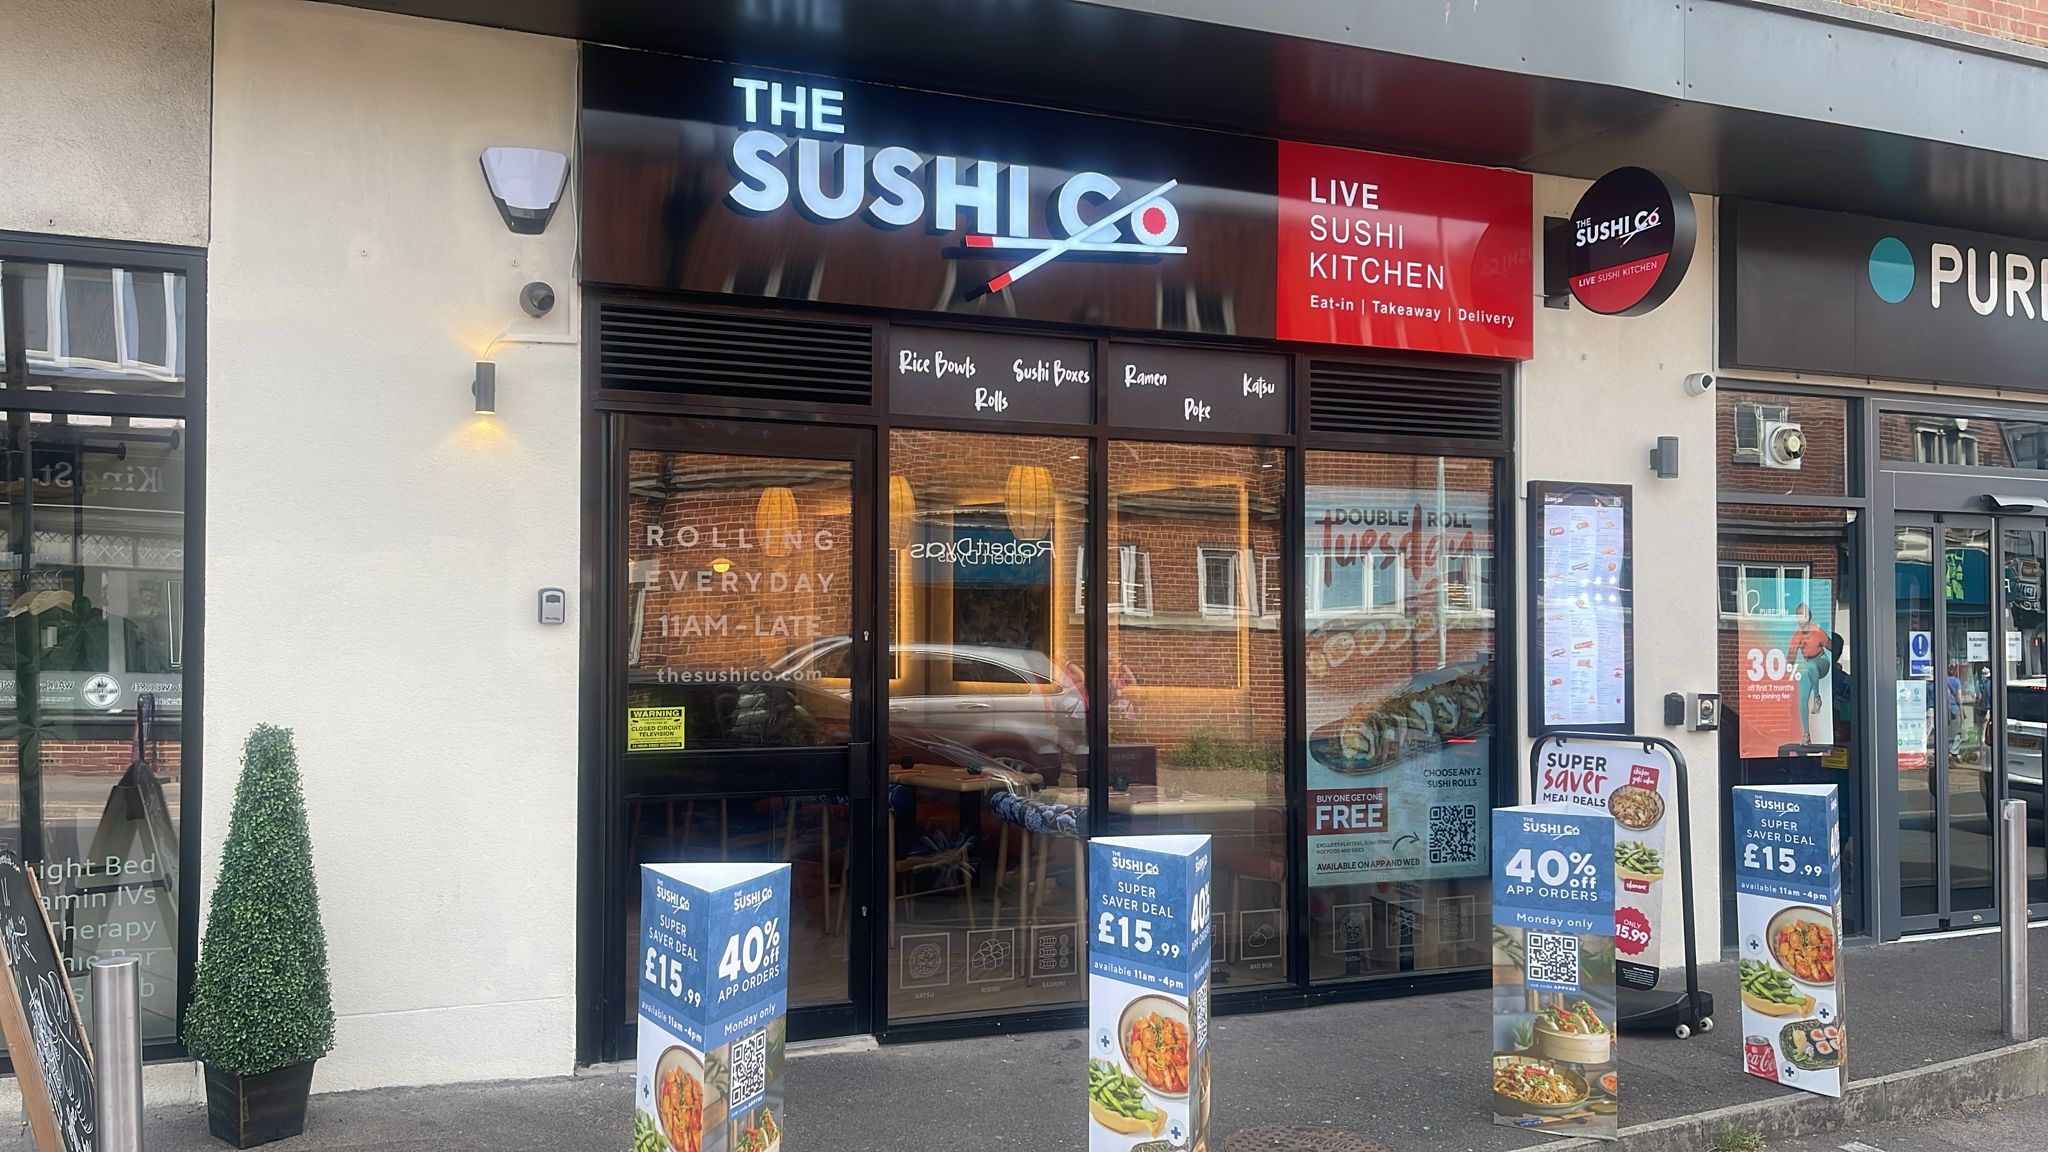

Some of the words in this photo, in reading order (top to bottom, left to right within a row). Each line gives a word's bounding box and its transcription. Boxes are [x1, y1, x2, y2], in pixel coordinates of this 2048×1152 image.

[733, 77, 845, 134] THE
[729, 130, 1029, 238] SUSHI
[1310, 177, 1379, 210] LIVE
[1310, 214, 1403, 250] SUSHI
[1576, 217, 1591, 229] THE
[1576, 215, 1630, 247] SUSHI
[1310, 252, 1444, 290] KITCHEN
[1578, 276, 1596, 287] LIVE
[1598, 270, 1621, 283] SUSHI
[1622, 261, 1658, 277] KITCHEN
[1931, 242, 2048, 322] PUR
[1310, 295, 1354, 312] Eat-in
[1372, 300, 1441, 322] Takeaway
[1458, 309, 1514, 329] Delivery
[899, 349, 930, 375] Rice
[934, 350, 976, 379] Bowls
[1012, 358, 1050, 383] Sushi
[1053, 359, 1090, 387] Boxes
[1124, 364, 1167, 388] Ramen
[1243, 373, 1275, 399] Katsu
[974, 387, 1008, 412] Rolls
[1184, 398, 1211, 423] Poke
[1335, 508, 1409, 527] DOUBLE
[1427, 511, 1472, 529] ROLL
[646, 525, 834, 551] ROLLING
[644, 570, 834, 593] EVERYDAY
[659, 615, 728, 637] 11AM
[755, 615, 822, 637] LATE
[656, 667, 822, 683] thesushico.com
[1747, 648, 1802, 682] 30%
[1761, 693, 1781, 702] joining
[633, 710, 680, 718] WARNING
[1423, 768, 1458, 778] CHOOSE
[1458, 767, 1476, 777] ANY
[1476, 767, 1482, 776] 2
[1547, 752, 1607, 772] SUPER
[1427, 779, 1451, 789] SUSHI
[1451, 778, 1478, 788] ROLLS
[1543, 769, 1608, 795] saver
[1316, 794, 1333, 803] BUY
[1333, 793, 1350, 802] ONE
[1351, 793, 1366, 802] GET
[1366, 792, 1384, 801] ONE
[1573, 795, 1606, 808] DEALS
[1754, 799, 1785, 811] SUSHI
[1315, 803, 1384, 831] FREE
[1523, 822, 1561, 834] SUSHI
[1761, 818, 1798, 831] SUPER
[1746, 829, 1781, 842] SAVER
[1784, 833, 1815, 846] DEAL
[105, 853, 156, 877] Bed
[1112, 856, 1143, 872] SUSHI
[1316, 861, 1357, 871] AVAILABLE
[1357, 861, 1370, 869] ON
[1370, 860, 1386, 868] APP
[1386, 859, 1403, 867] AND
[1403, 858, 1420, 866] WEB
[1505, 848, 1597, 886] 40%
[1117, 881, 1156, 899] SUPER
[1506, 884, 1534, 896] APP
[1538, 887, 1598, 902] ORDERS
[1570, 876, 1597, 889] off
[1740, 882, 1777, 894] available
[1779, 887, 1800, 897] 11am
[41, 888, 107, 911] amin
[117, 884, 156, 907] IVs
[656, 886, 679, 906] SUSHI
[733, 892, 760, 911] SUSHI
[1102, 894, 1138, 912] SAVER
[1142, 903, 1174, 919] DEAL
[660, 914, 687, 938] SUPER
[1516, 912, 1563, 927] Monday
[1567, 916, 1593, 930] only
[1623, 919, 1642, 930] ONLY
[648, 926, 674, 950] SAVER
[675, 940, 699, 962] DEAL
[718, 917, 780, 982] 40%
[763, 946, 780, 968] off
[1094, 960, 1132, 978] available
[1133, 969, 1156, 983] 11am
[717, 985, 740, 1004] APP
[741, 964, 780, 992] ORDERS
[641, 1000, 668, 1023] available
[668, 1015, 684, 1032] 11am
[724, 1012, 758, 1037] Monday
[759, 1002, 777, 1020] only
